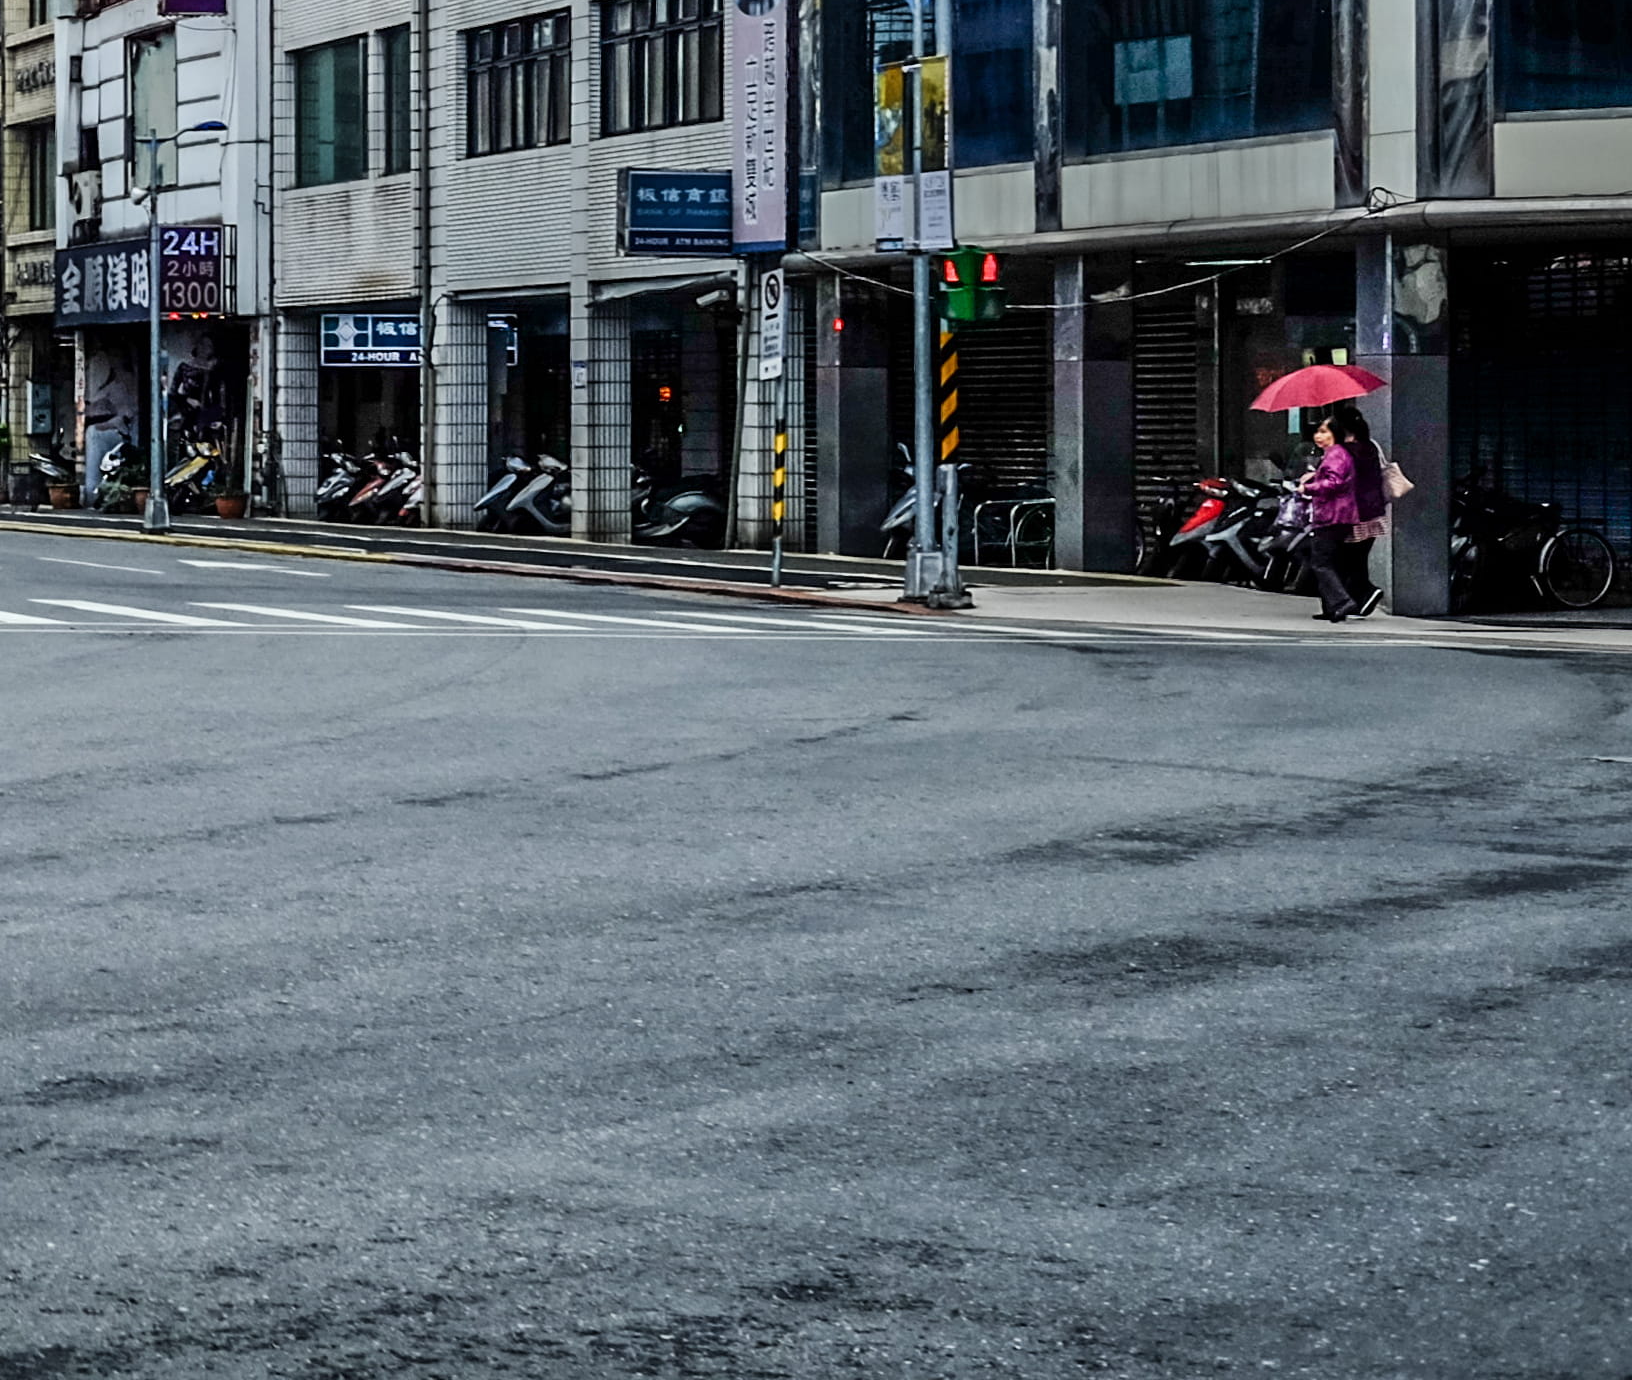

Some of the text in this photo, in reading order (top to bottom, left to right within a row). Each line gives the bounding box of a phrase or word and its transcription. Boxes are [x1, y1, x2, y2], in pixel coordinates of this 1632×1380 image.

[163, 231, 219, 255] 24H
[163, 281, 219, 308] 1300
[351, 352, 400, 362] 24-HOUR
